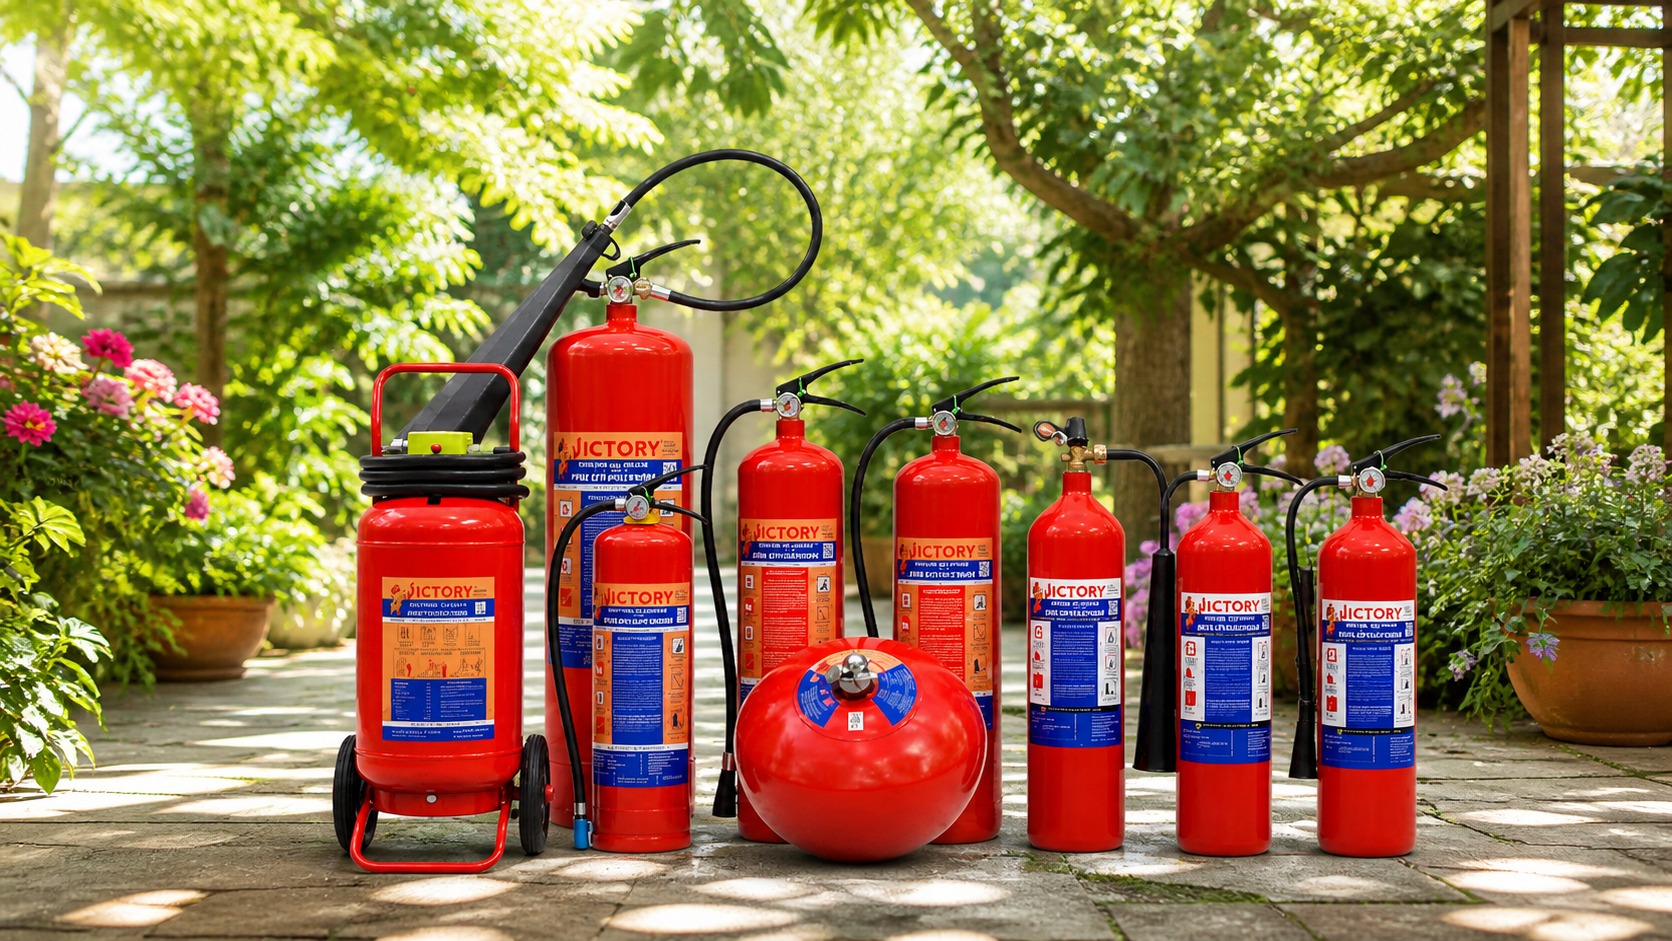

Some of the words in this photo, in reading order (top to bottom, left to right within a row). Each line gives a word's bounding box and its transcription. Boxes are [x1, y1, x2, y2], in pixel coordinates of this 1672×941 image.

[572, 437, 660, 459] VICTORY
[753, 523, 820, 541] VICTORY
[603, 588, 673, 606] VICTORY
[1044, 583, 1106, 599] VICTORY
[1198, 597, 1260, 614] VICTORY
